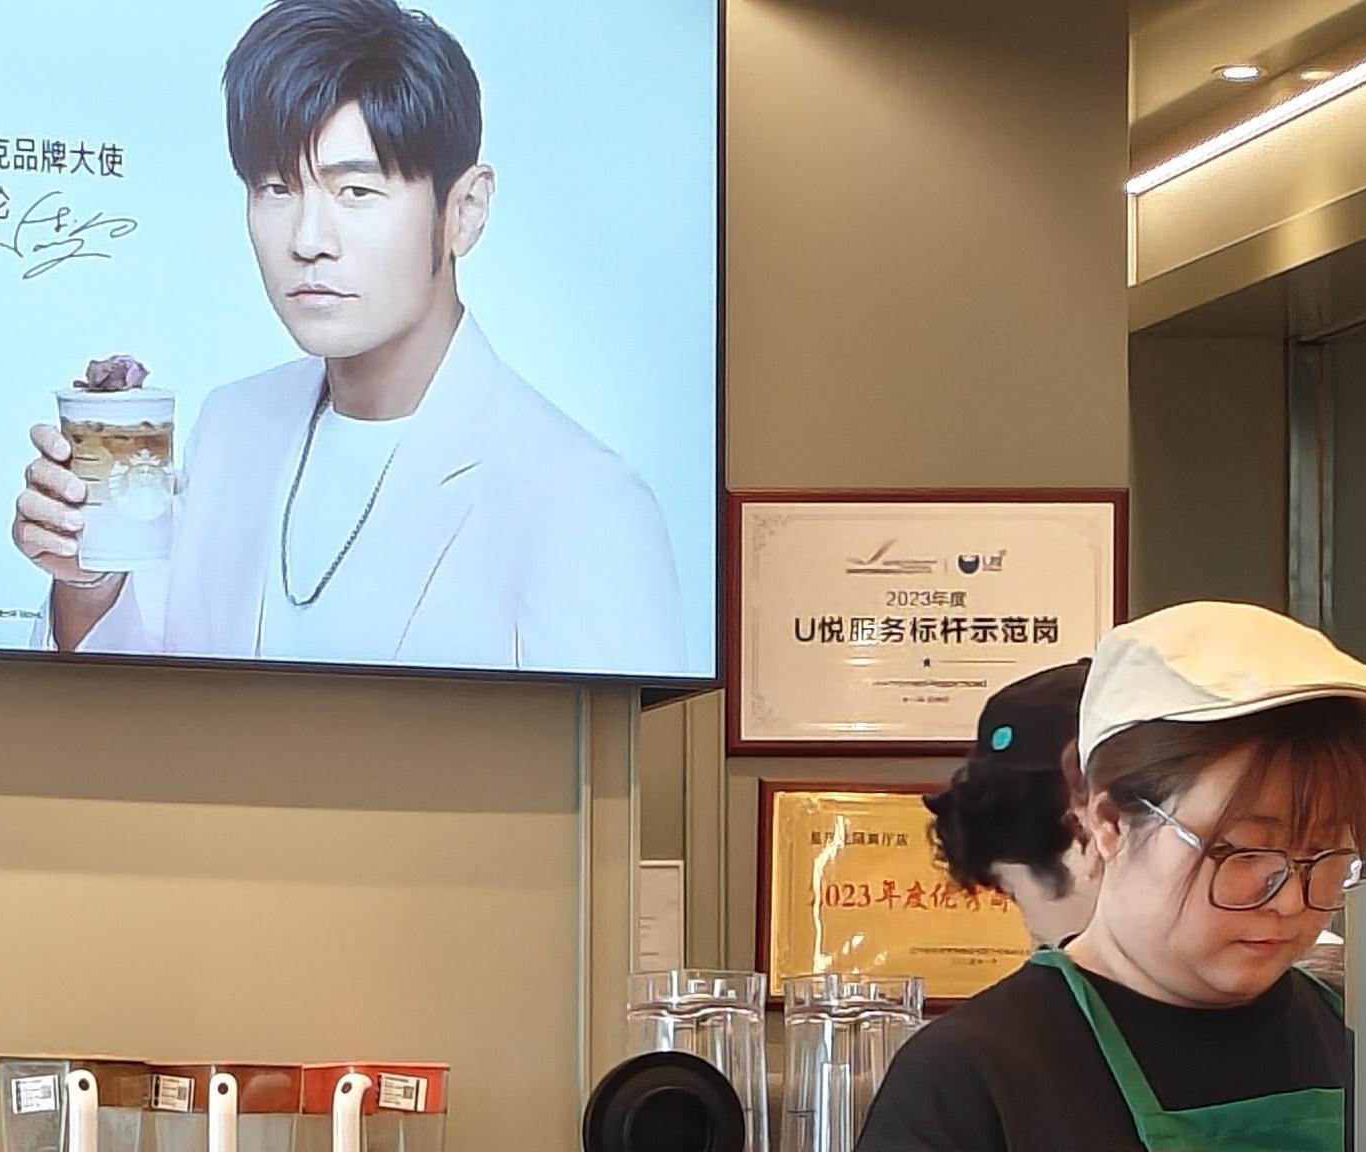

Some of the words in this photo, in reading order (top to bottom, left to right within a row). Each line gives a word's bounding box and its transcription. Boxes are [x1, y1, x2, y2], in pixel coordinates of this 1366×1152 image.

[885, 590, 968, 609] 2023年度
[794, 616, 1059, 644] U悦服务标杆示范岗
